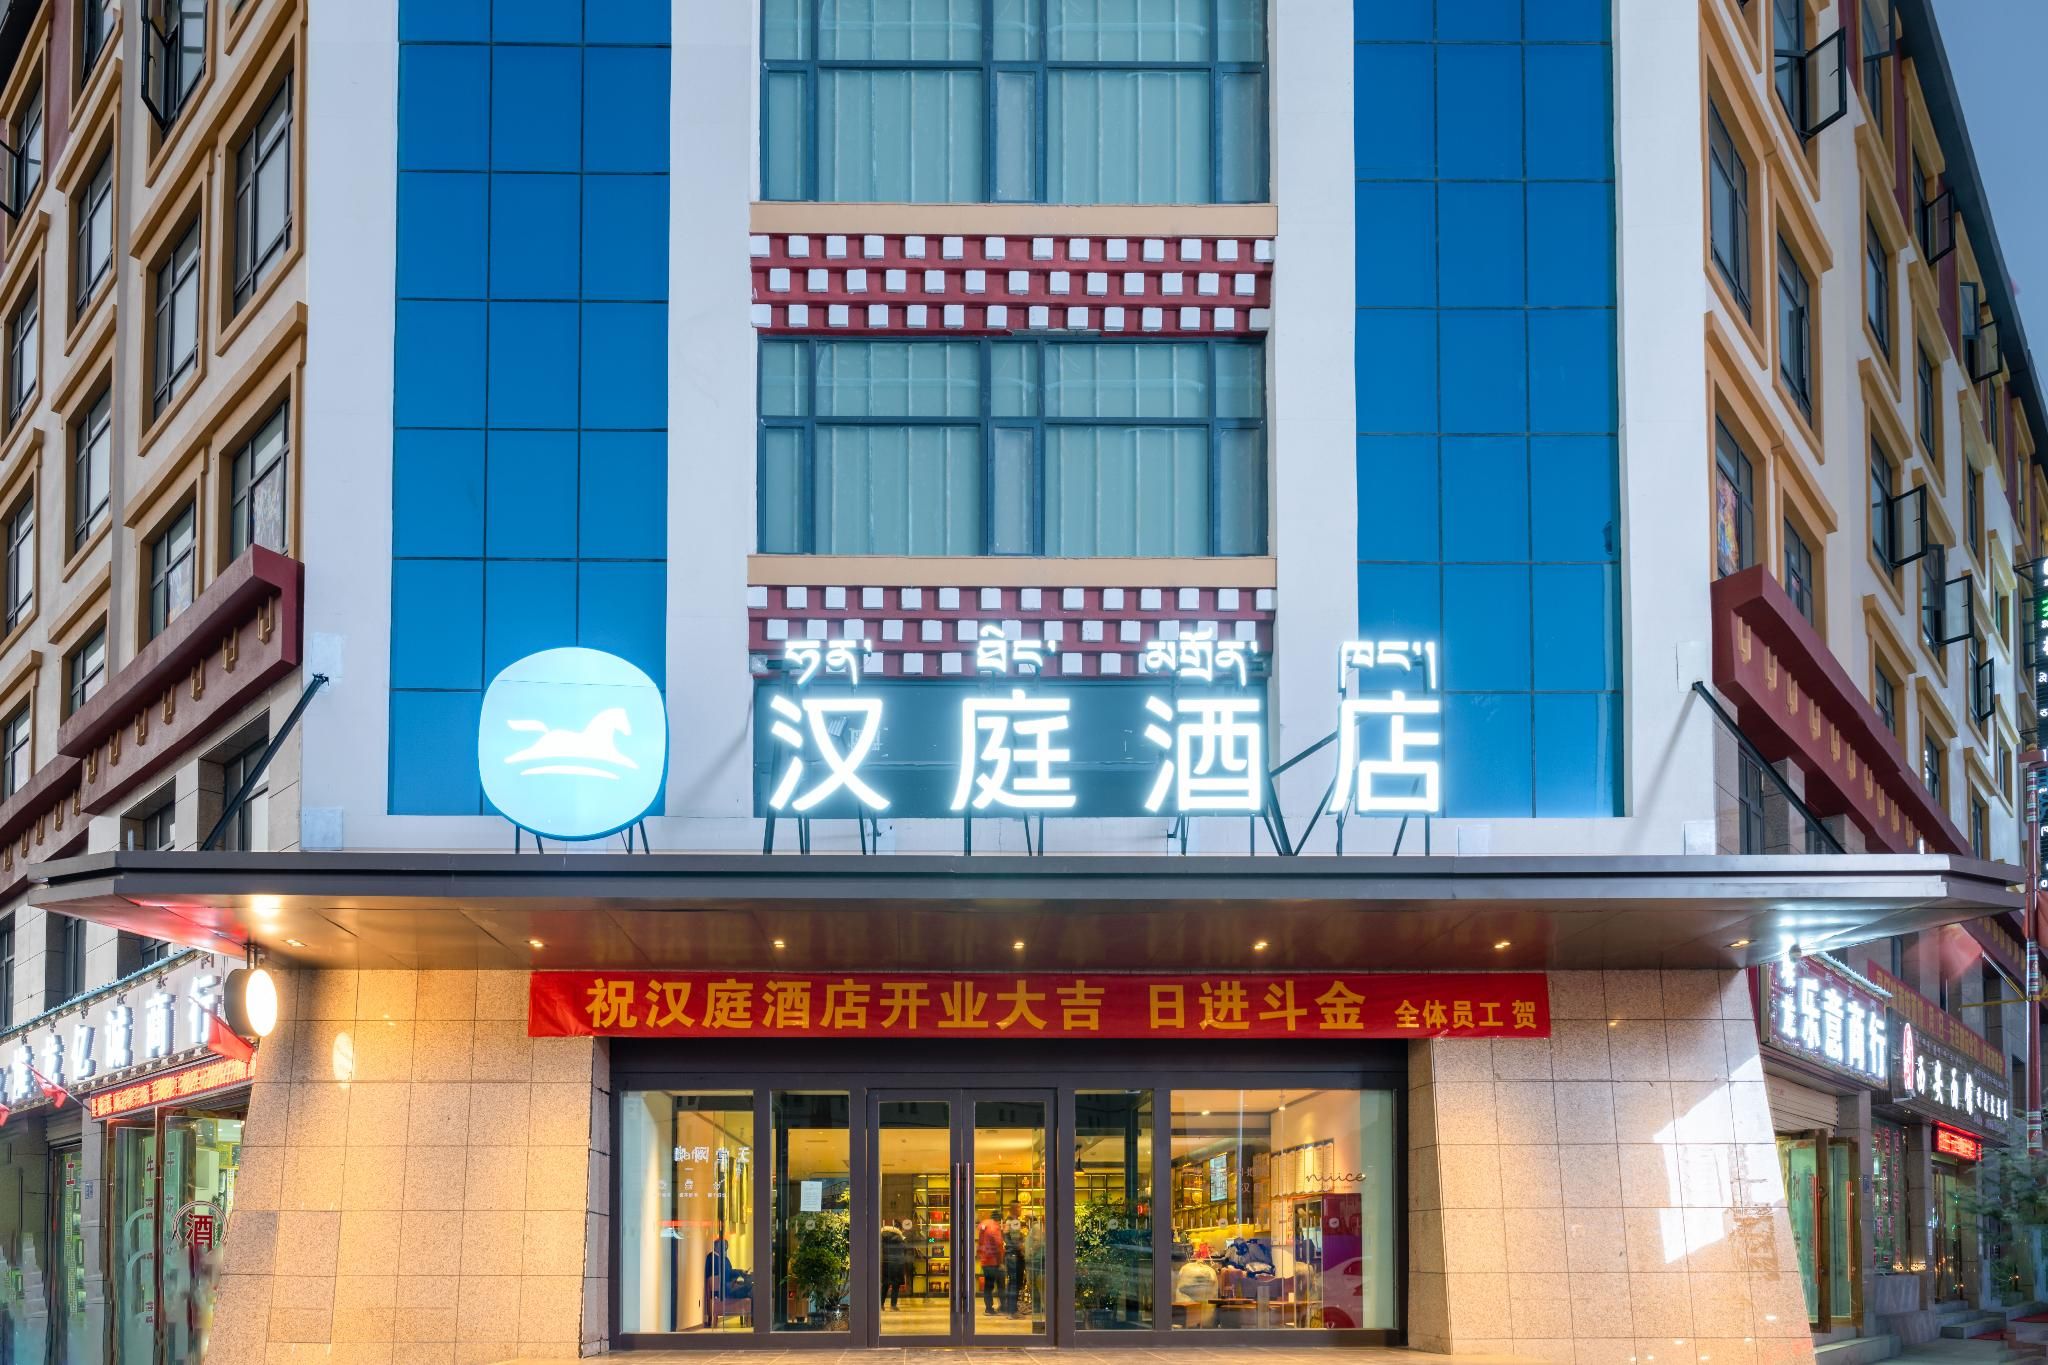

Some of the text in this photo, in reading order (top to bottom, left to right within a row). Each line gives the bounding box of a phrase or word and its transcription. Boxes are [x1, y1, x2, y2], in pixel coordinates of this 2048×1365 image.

[769, 689, 1441, 814] 汉庭酒店
[586, 978, 1537, 1031] 祝汉庭酒店开业大吉 日进斗金 全体员工 贺
